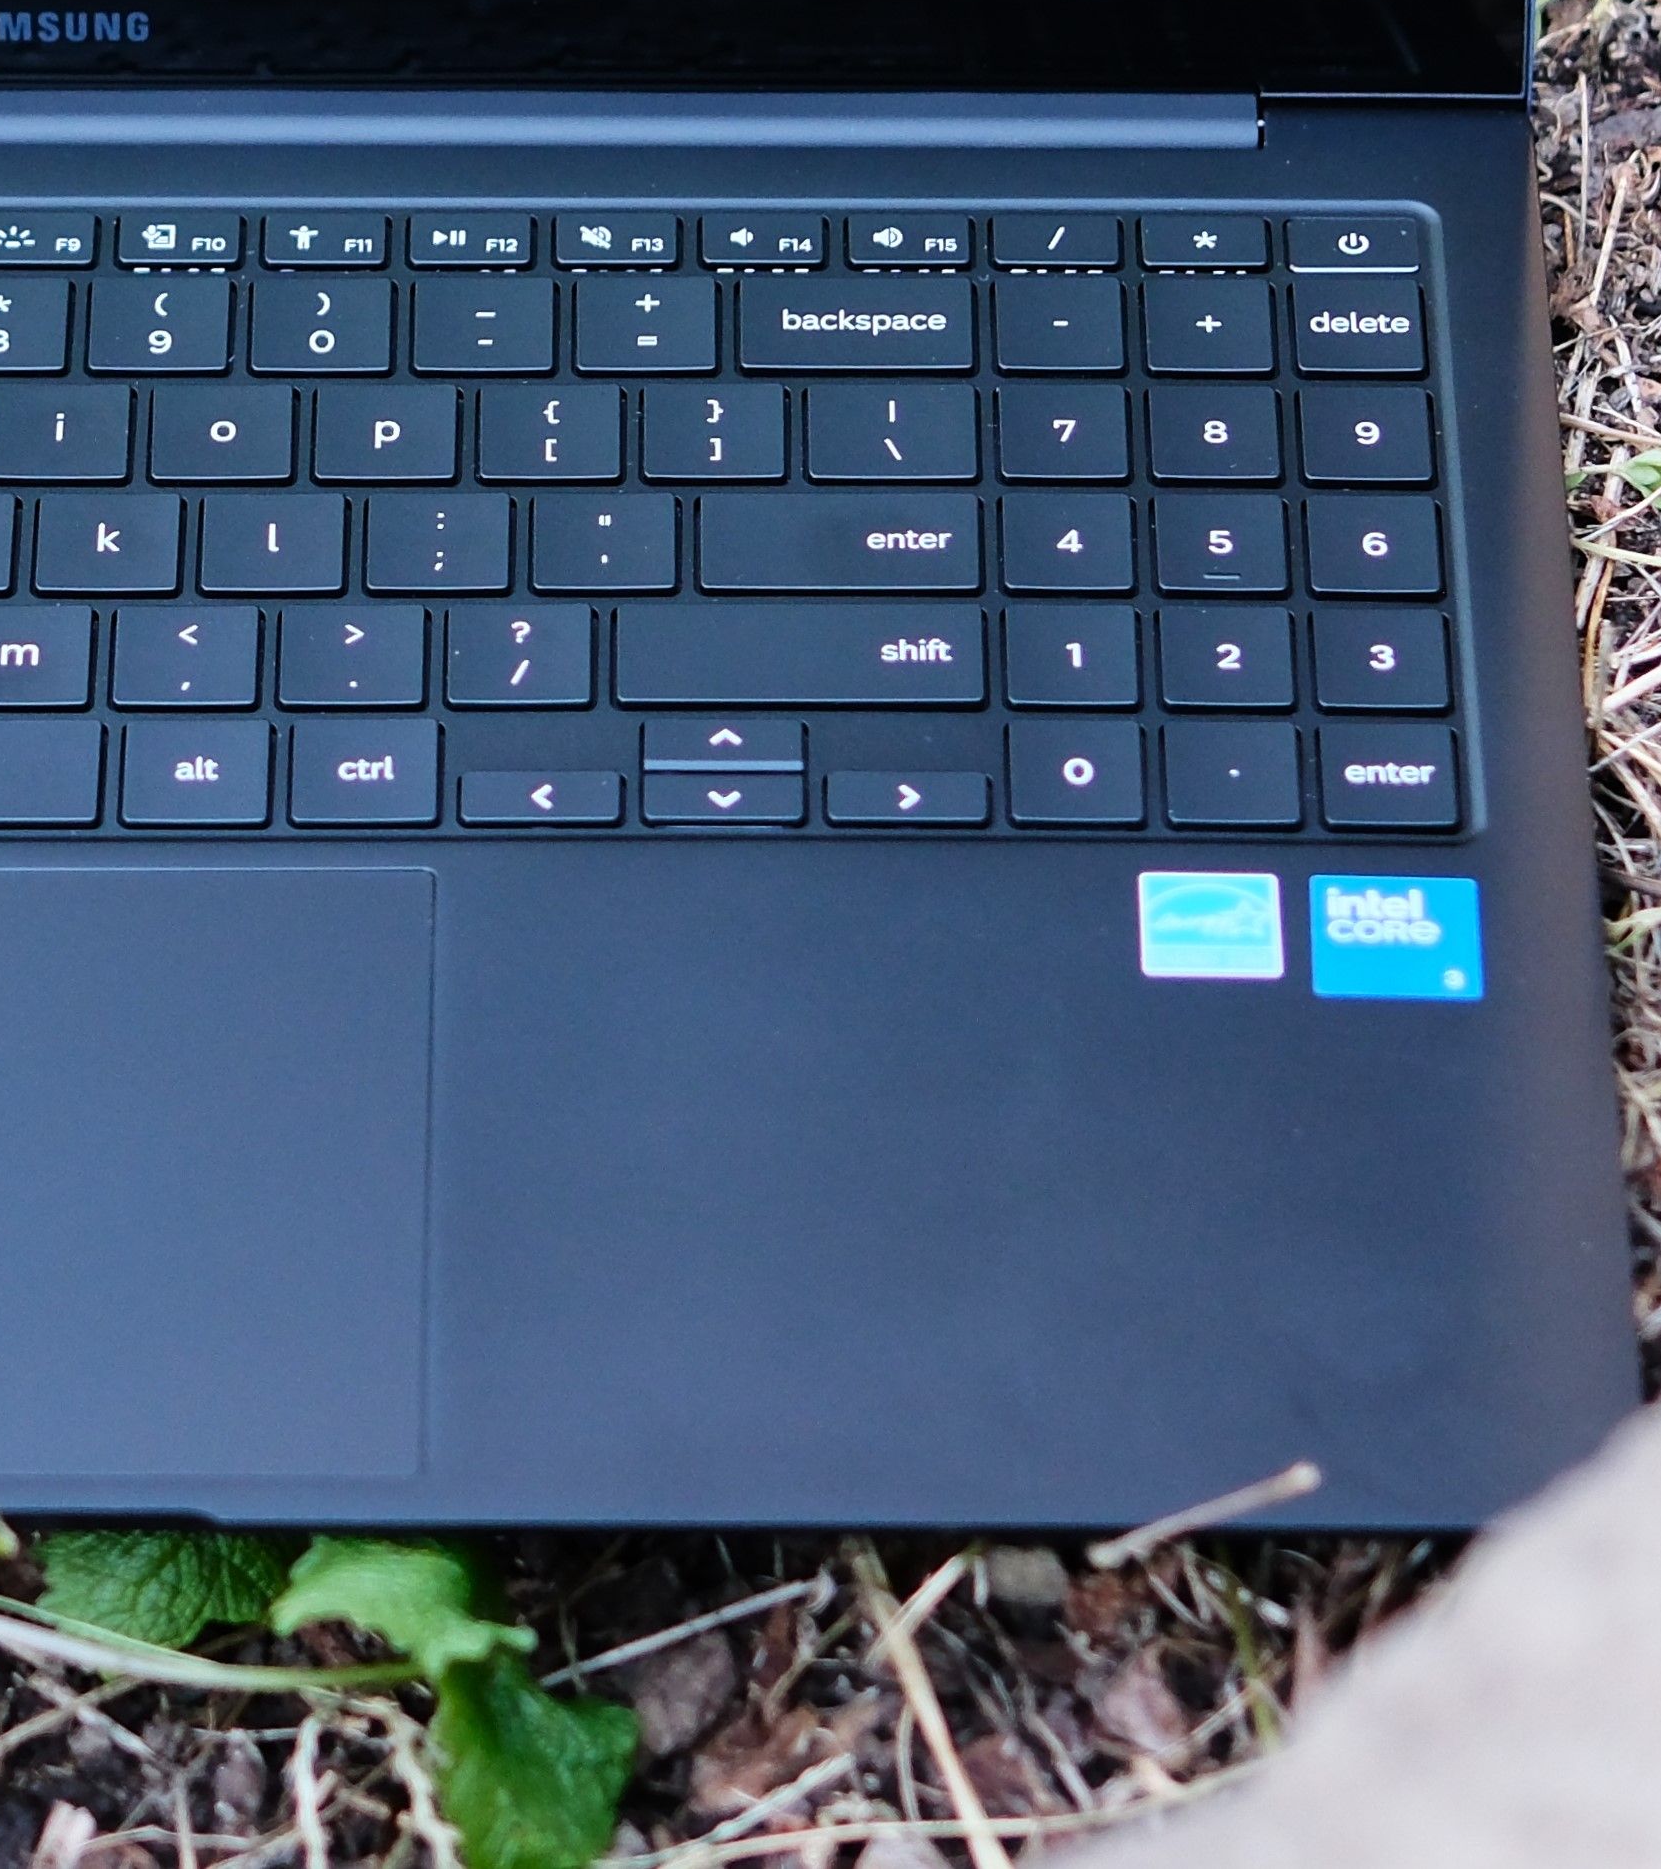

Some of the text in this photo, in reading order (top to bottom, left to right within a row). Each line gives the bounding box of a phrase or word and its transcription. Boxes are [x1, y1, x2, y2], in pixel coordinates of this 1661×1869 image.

[55, 237, 82, 252] F9
[191, 237, 227, 252] F10
[344, 238, 373, 253] F11
[485, 238, 519, 253] F12
[631, 237, 664, 252] F13
[778, 237, 813, 253] F14
[924, 238, 958, 252] F15
[782, 308, 947, 336] backspace
[1309, 311, 1410, 334] delete
[148, 330, 173, 355] 9
[55, 412, 65, 442] i
[210, 420, 237, 443] o
[374, 420, 401, 449] p
[1052, 419, 1077, 443] 7
[1203, 420, 1229, 444] 8
[1354, 421, 1380, 445] 9
[96, 522, 120, 553] k
[268, 523, 280, 553] l
[866, 529, 953, 550] enter
[1056, 529, 1083, 553] 4
[1208, 529, 1234, 554] 5
[1362, 531, 1389, 557] 6
[0, 643, 40, 667] m
[880, 637, 953, 662] shift
[1065, 642, 1082, 668] 1
[1216, 643, 1241, 670] 2
[1369, 644, 1395, 671] 3
[174, 755, 219, 781] alt
[337, 755, 395, 781] ctrl
[1344, 762, 1436, 785] enter
[1326, 887, 1424, 919] intel
